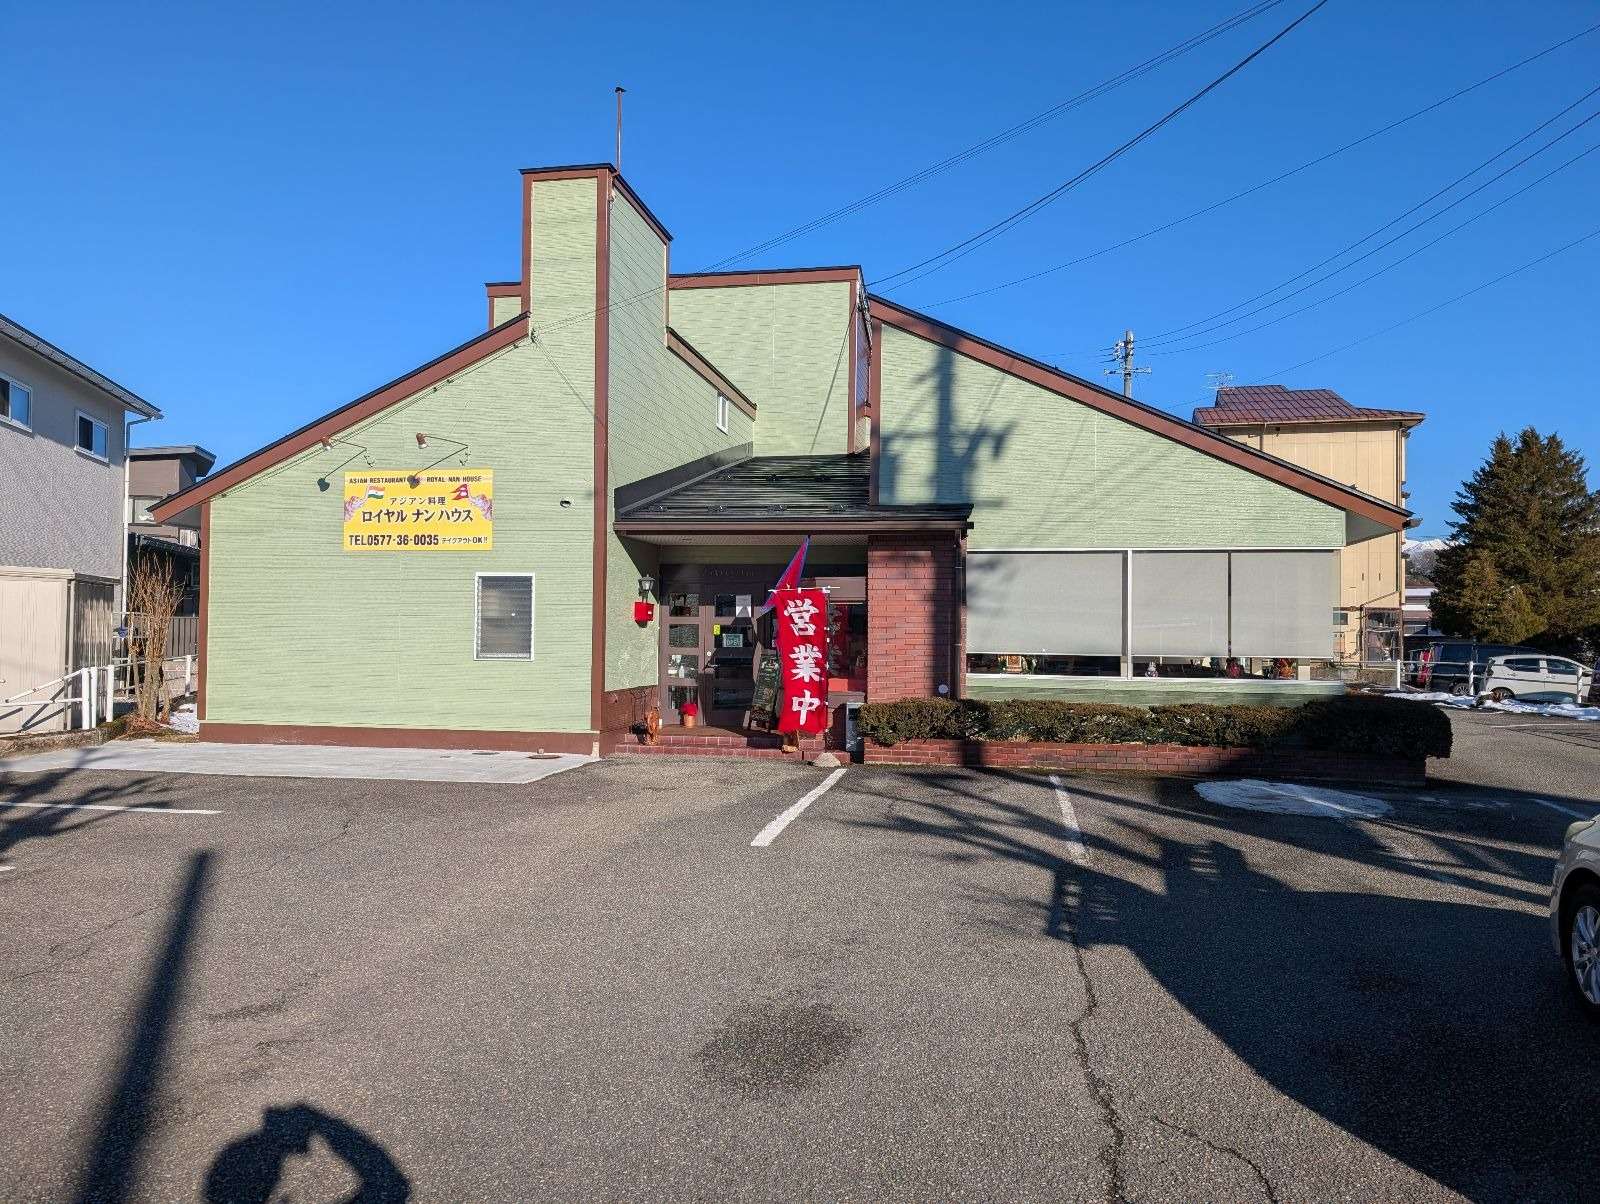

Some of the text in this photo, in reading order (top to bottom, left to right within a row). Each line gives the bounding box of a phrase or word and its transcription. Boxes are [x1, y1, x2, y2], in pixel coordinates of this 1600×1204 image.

[390, 496, 446, 505] アジアン料理
[361, 508, 473, 523] ロイヤル ナン ハウス
[783, 598, 825, 726] 営業中
